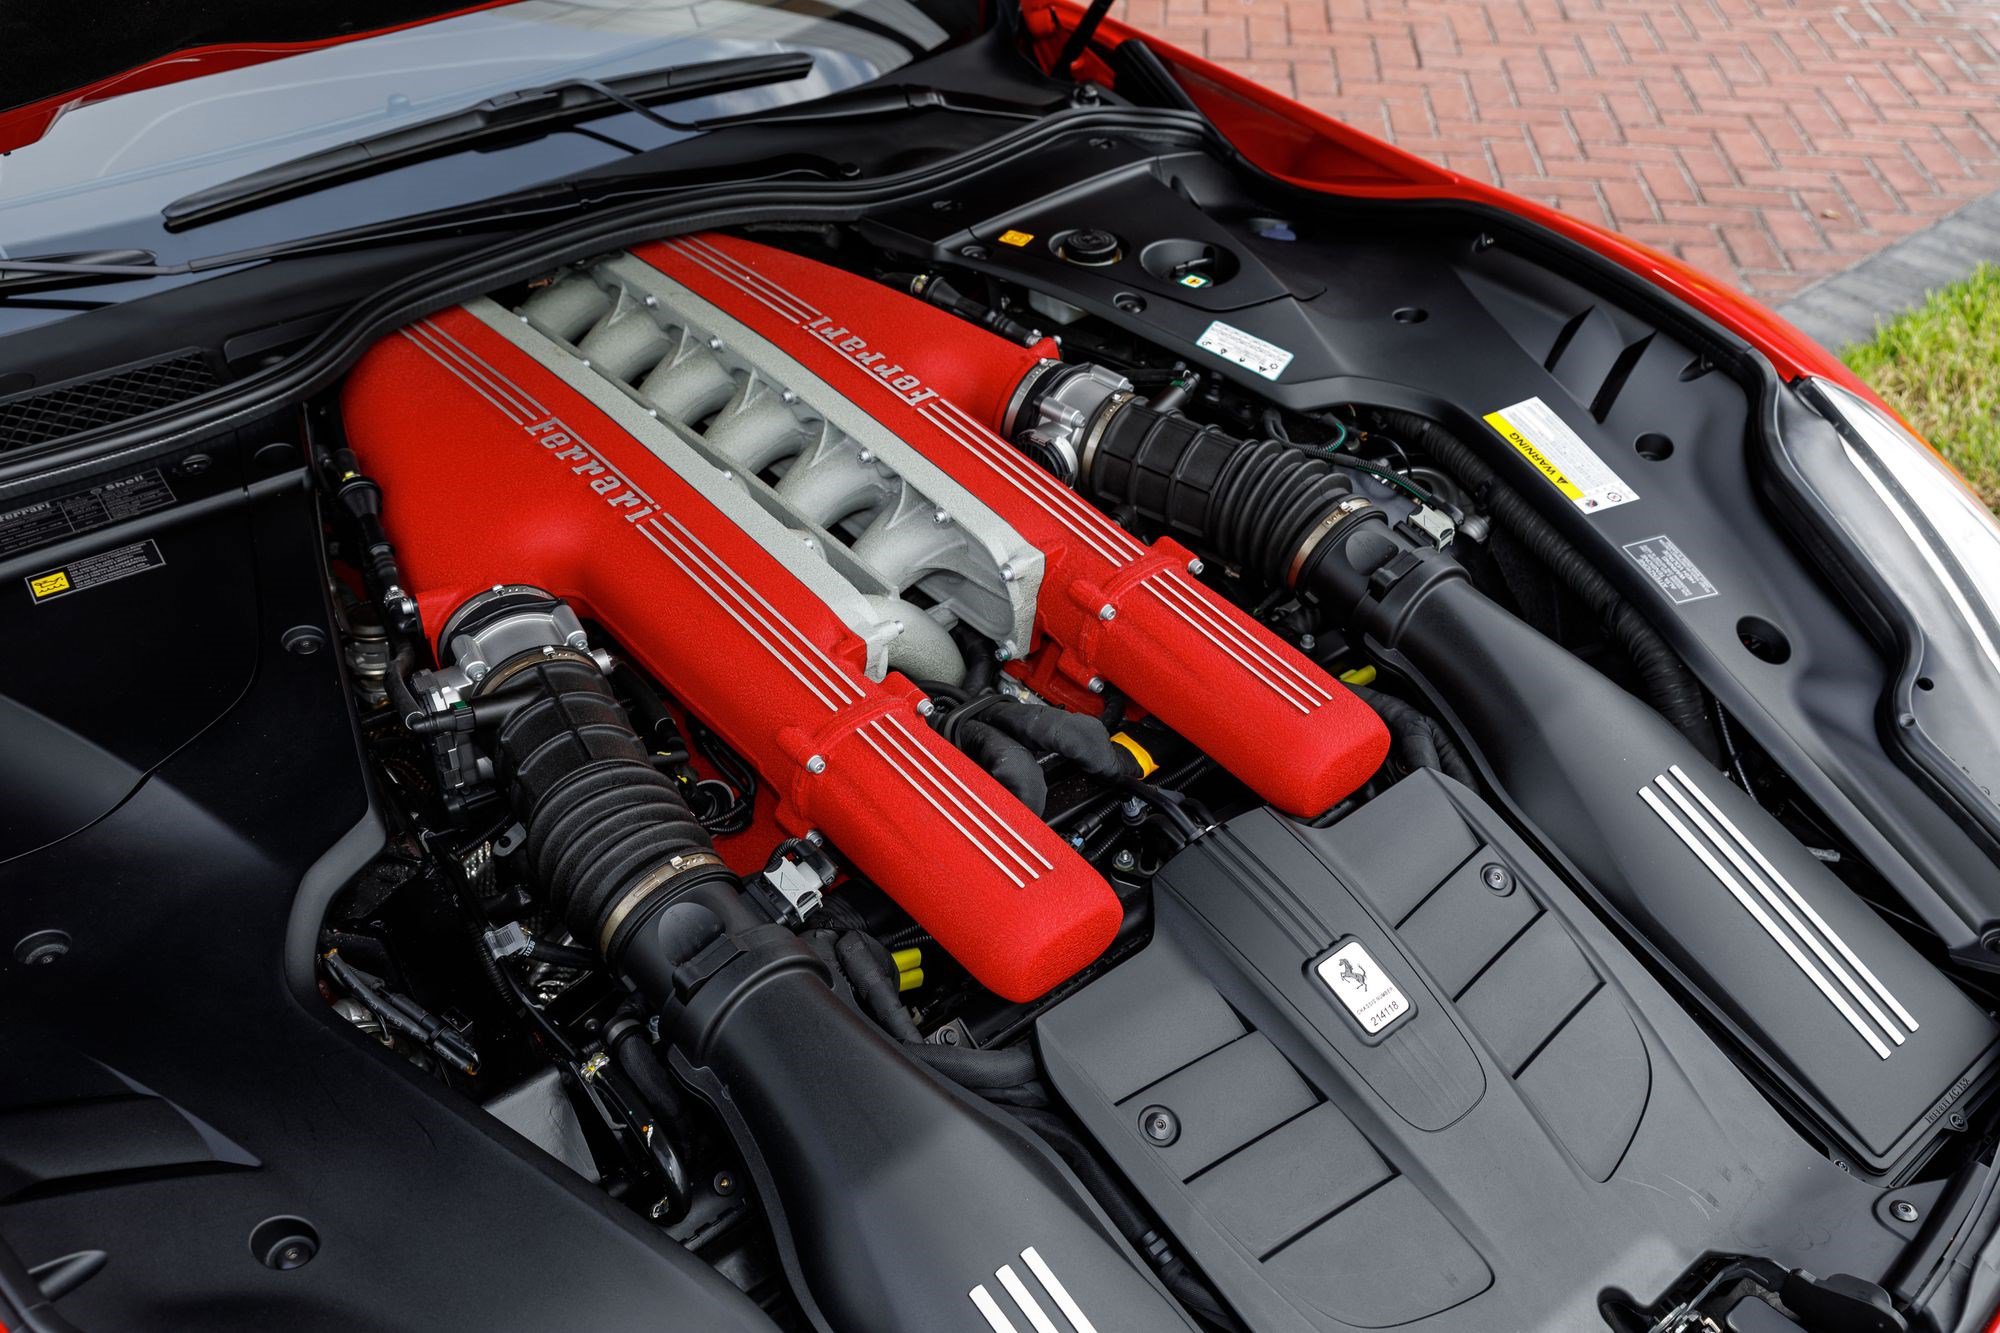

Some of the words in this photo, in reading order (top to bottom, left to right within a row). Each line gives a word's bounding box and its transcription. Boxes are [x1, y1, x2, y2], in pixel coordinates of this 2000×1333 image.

[801, 315, 941, 407] Ferrari
[523, 417, 660, 523] Ferrari
[1509, 432, 1556, 475] WARNING
[105, 475, 143, 491] Shell
[1356, 999, 1376, 1015] CHASSIS
[1376, 987, 1393, 1000] NUMBER
[1370, 1001, 1399, 1026] 214118
